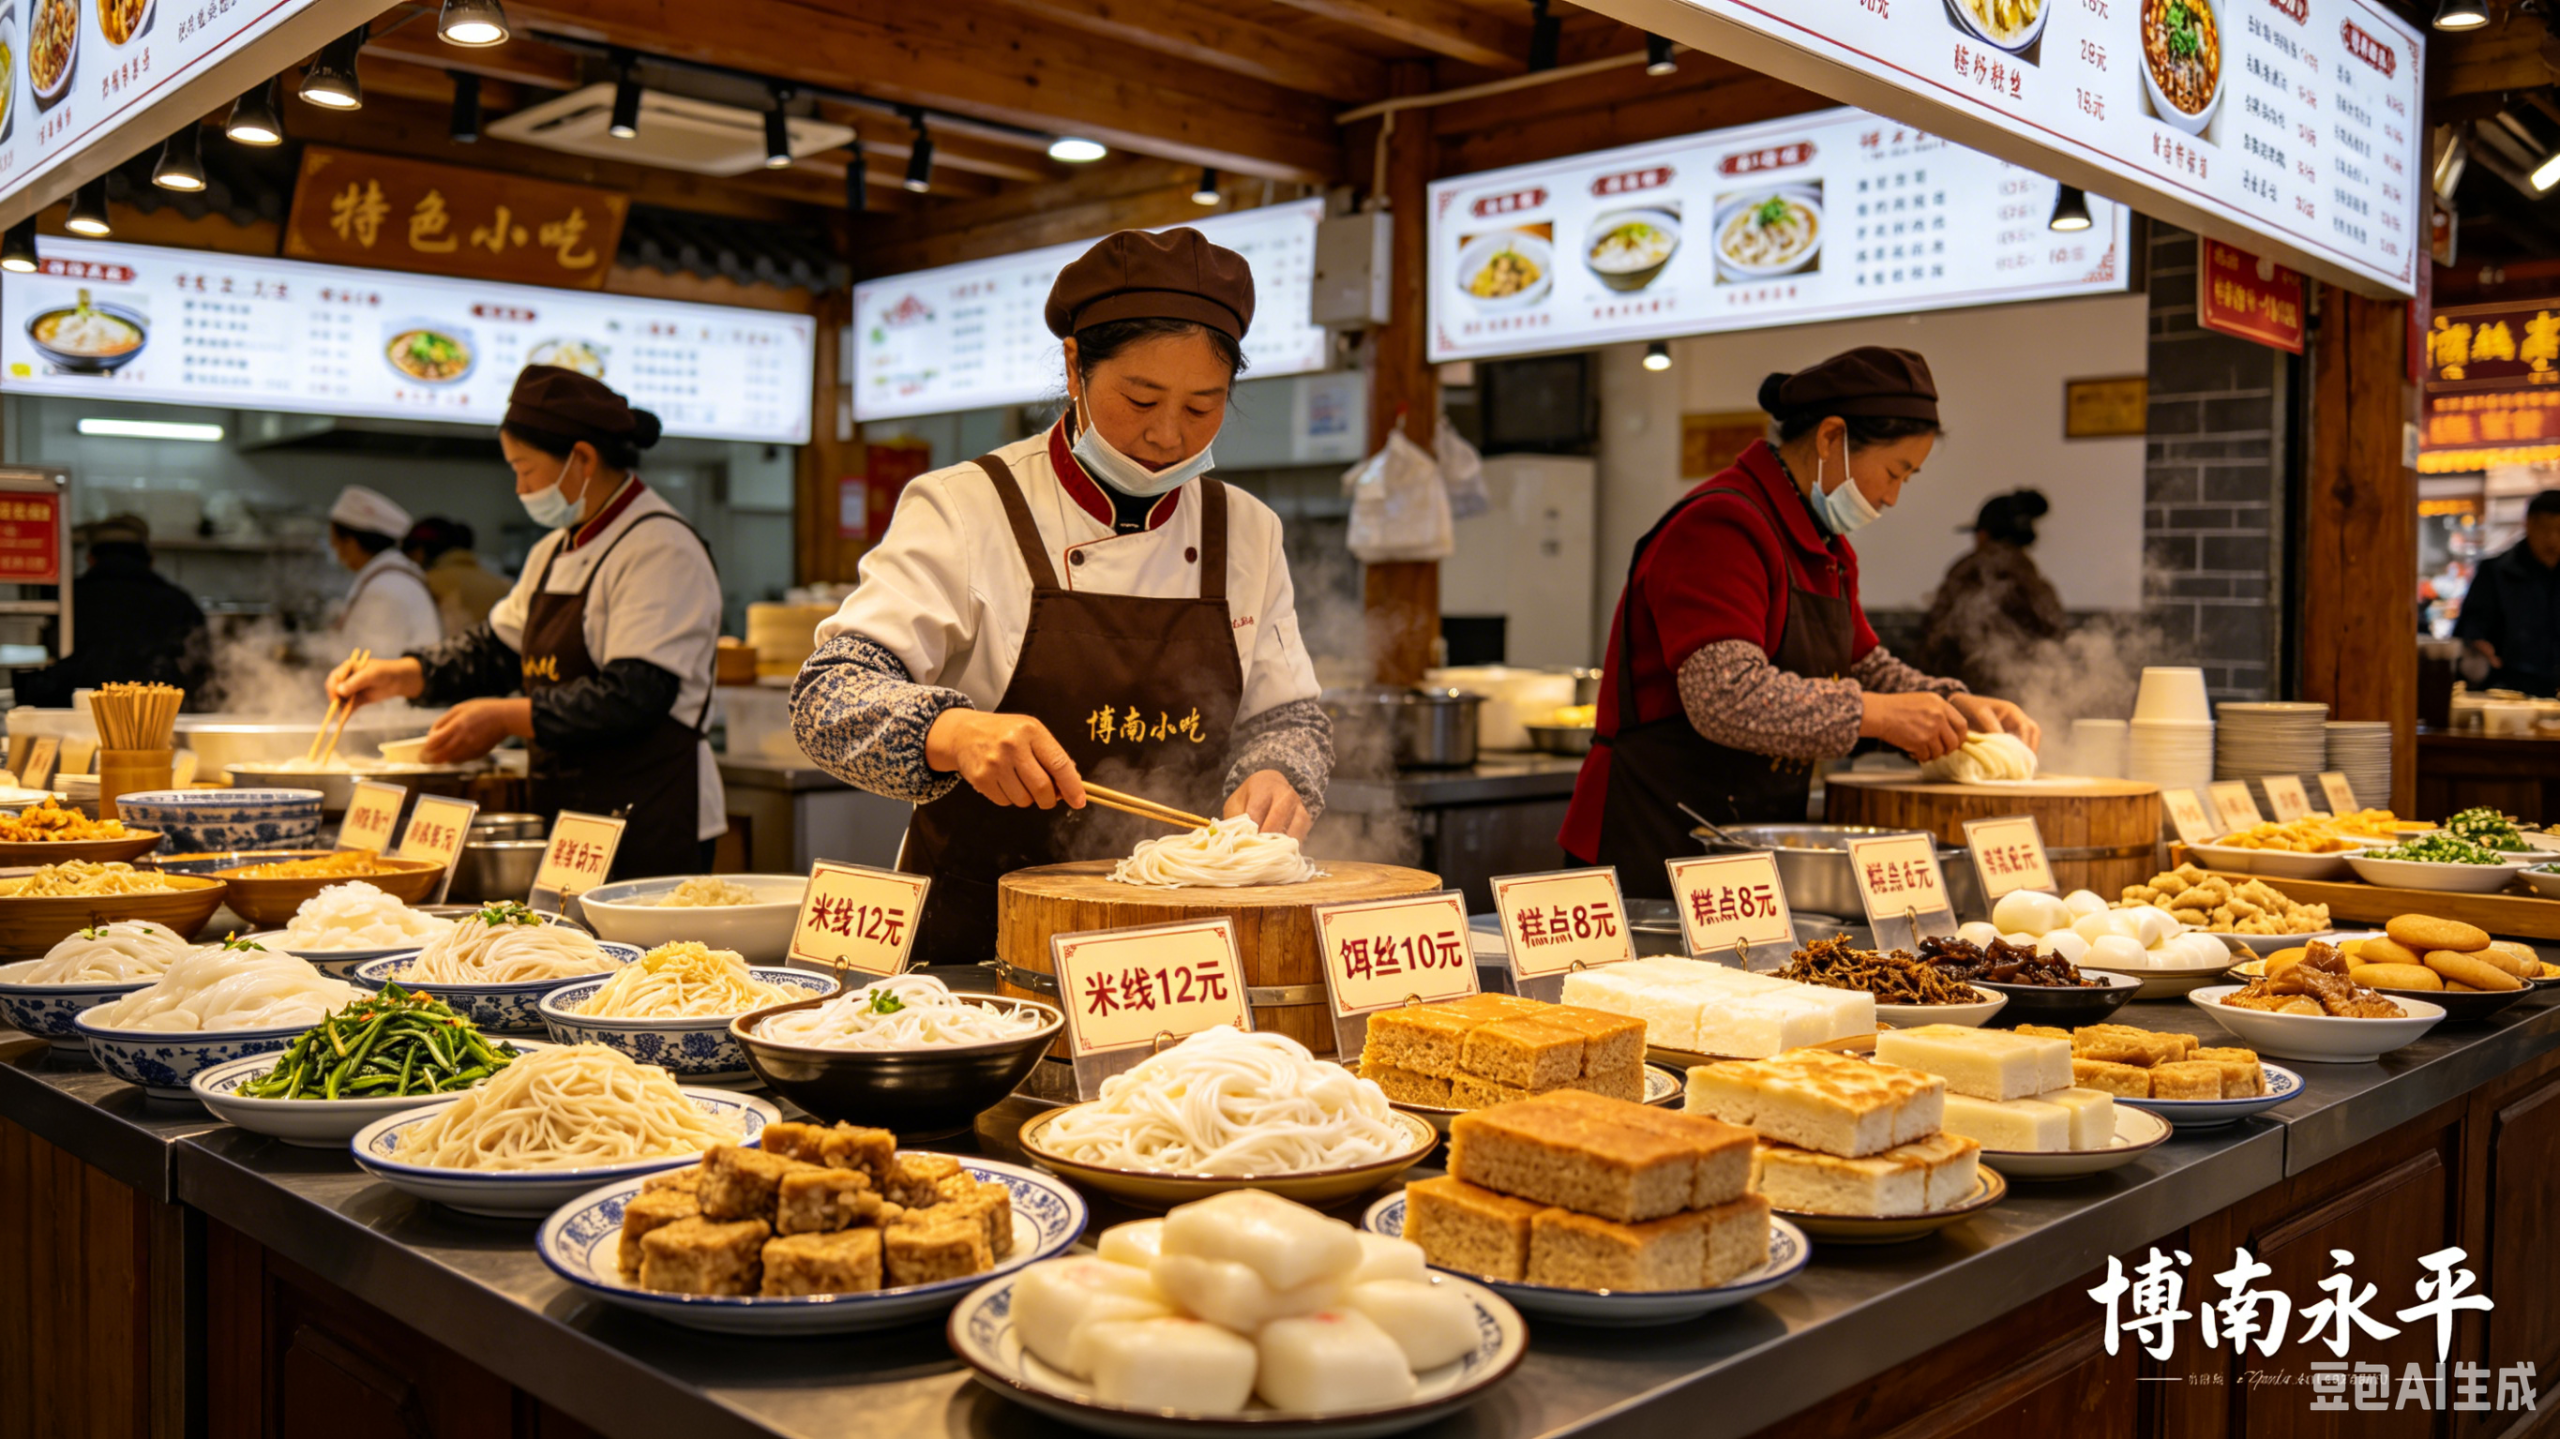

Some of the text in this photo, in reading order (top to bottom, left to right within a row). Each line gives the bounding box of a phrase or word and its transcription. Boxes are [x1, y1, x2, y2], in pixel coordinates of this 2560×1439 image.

[330, 179, 598, 269] 特色小吃
[1086, 704, 1206, 744] 博南小吃
[807, 892, 905, 947] 米线12元
[1517, 902, 1617, 948] 糕点8元
[1690, 884, 1777, 927] 糕点8元
[1339, 930, 1463, 981] 饵丝10元
[1085, 960, 1228, 1017] 米线12元
